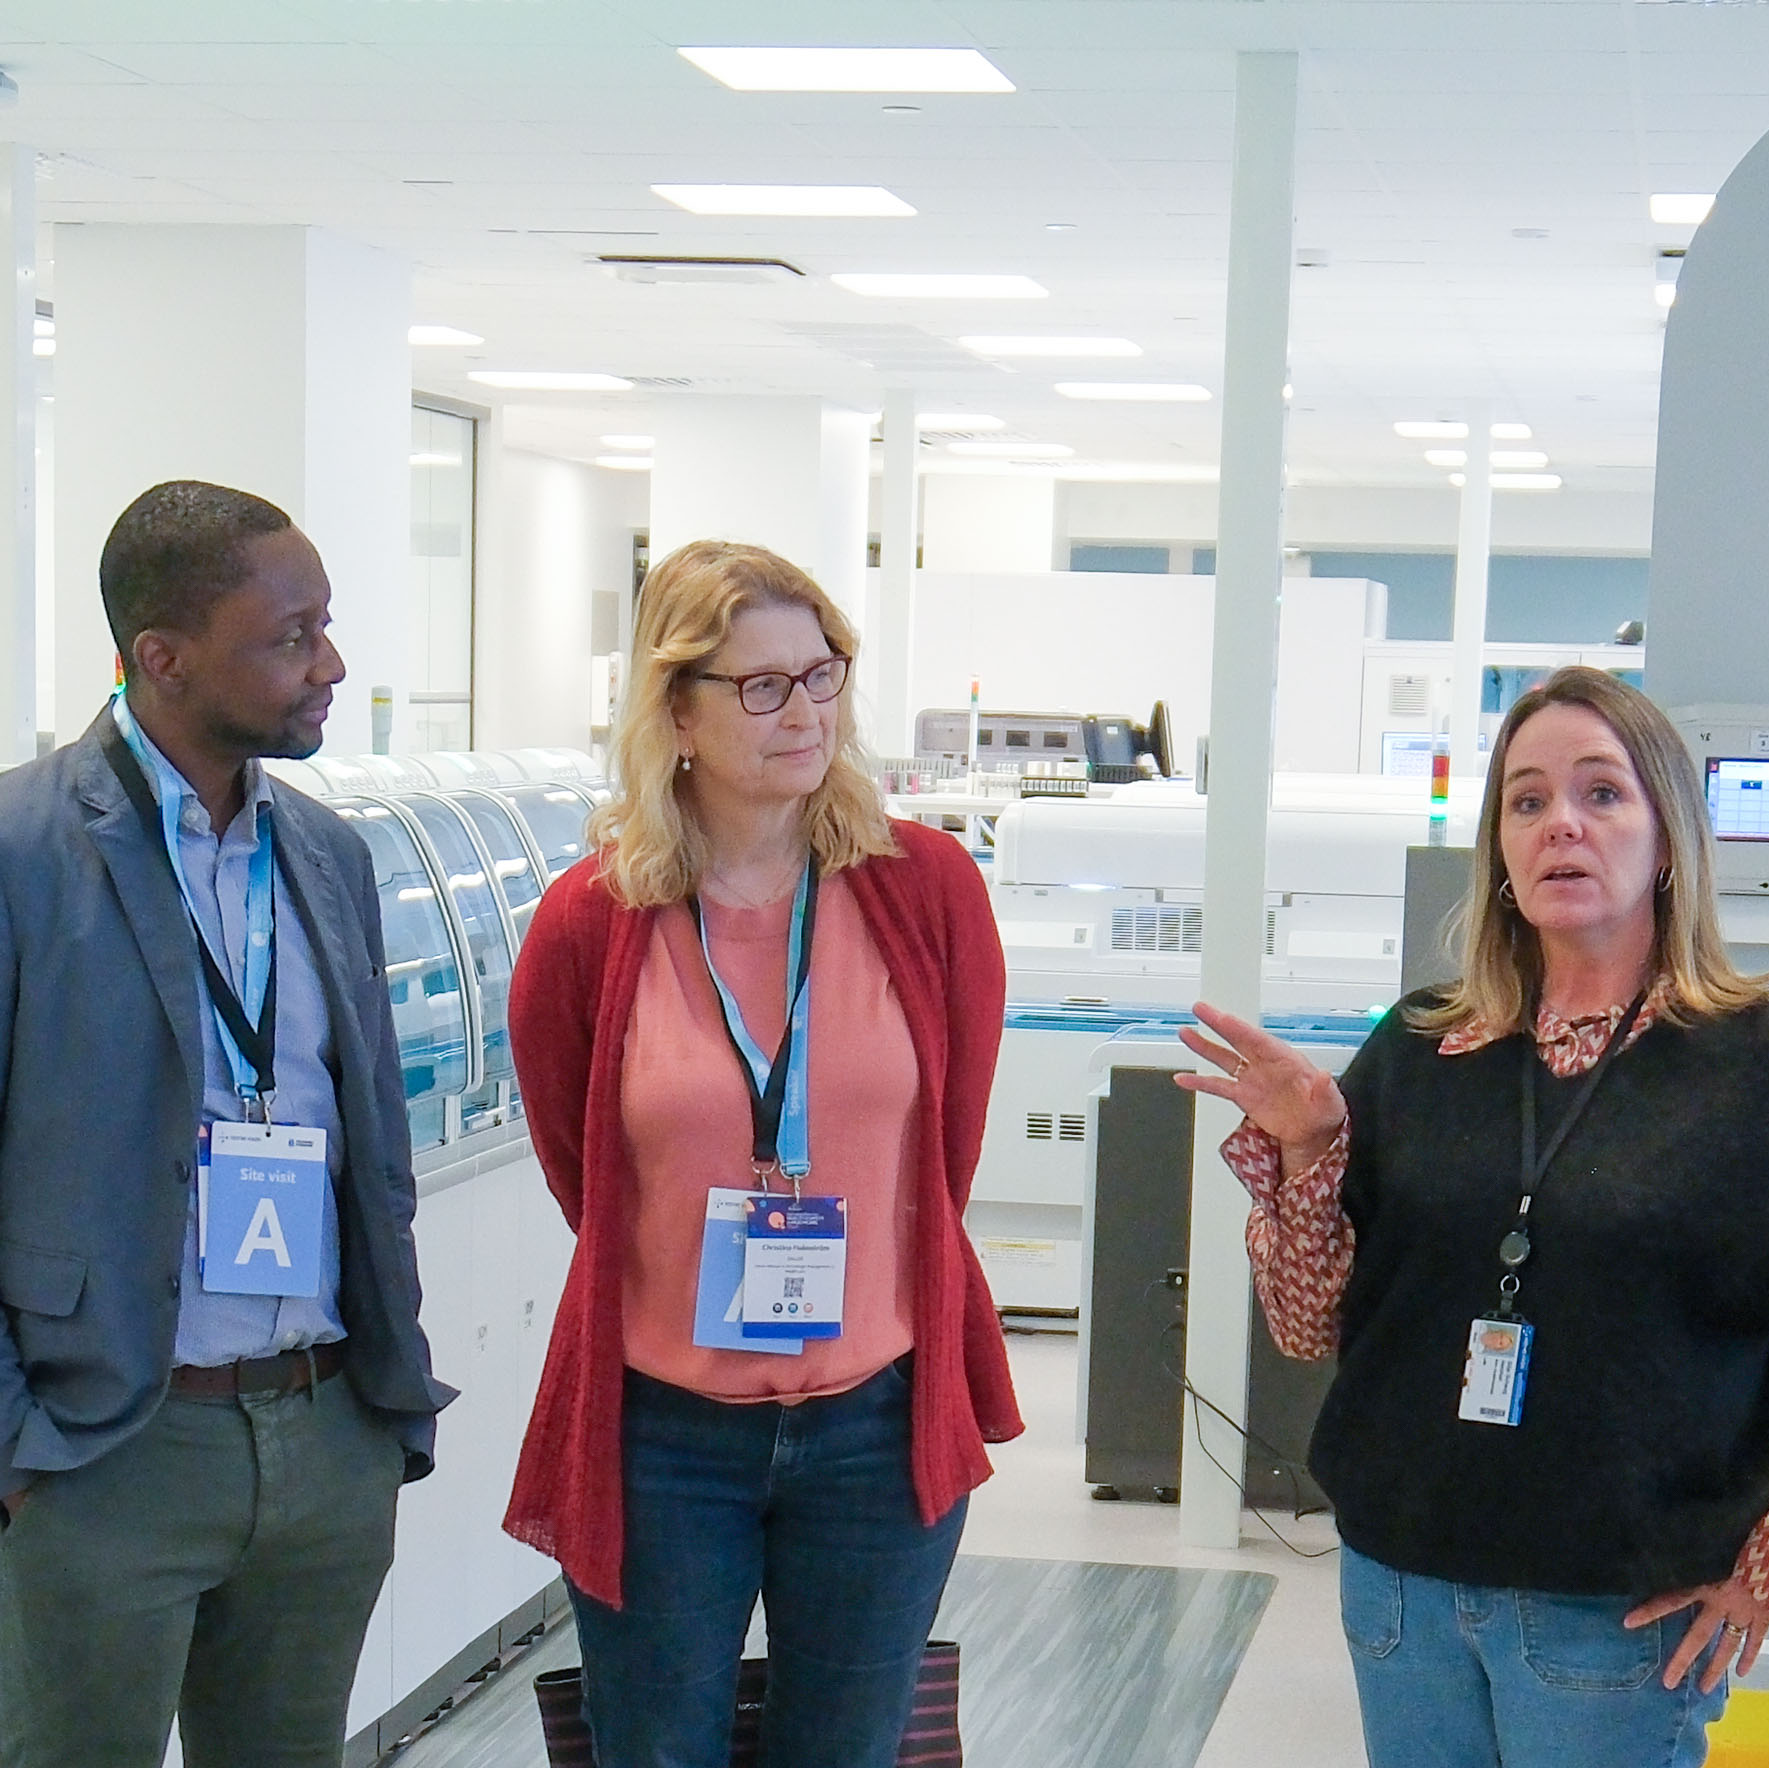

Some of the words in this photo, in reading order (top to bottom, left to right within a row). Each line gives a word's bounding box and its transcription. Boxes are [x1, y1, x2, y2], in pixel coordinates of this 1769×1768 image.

[239, 1167, 265, 1181] Site
[268, 1169, 296, 1184] visit
[234, 1197, 292, 1268] A
